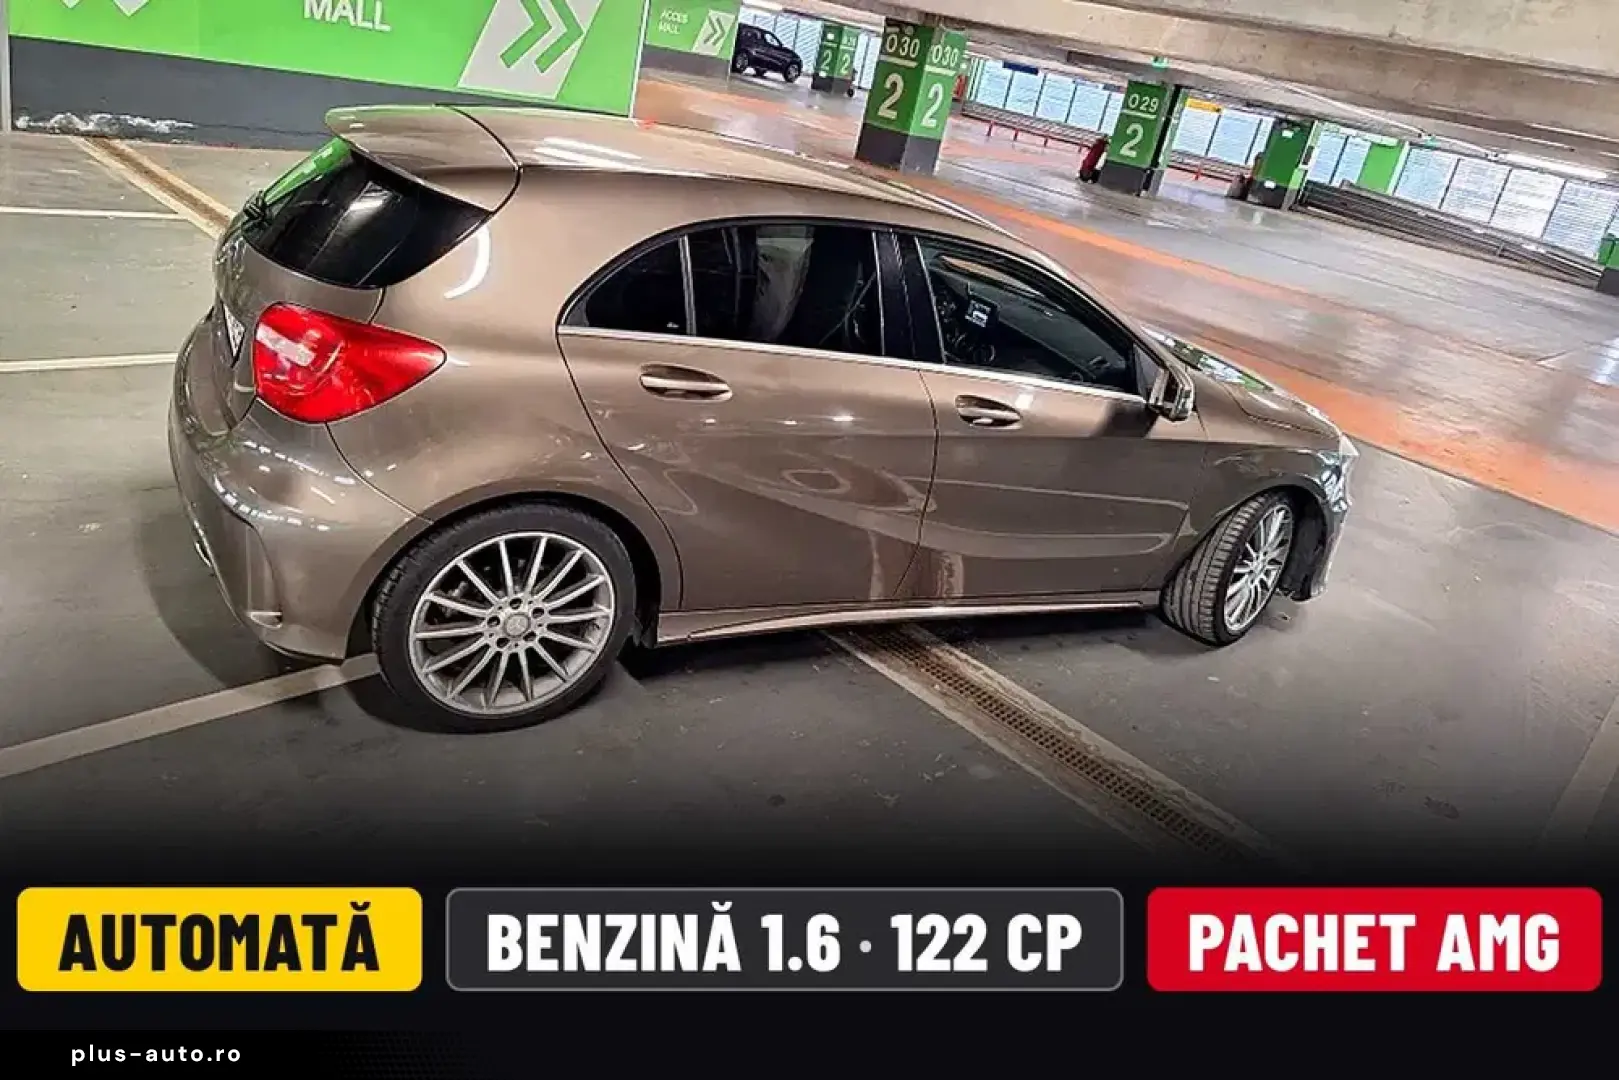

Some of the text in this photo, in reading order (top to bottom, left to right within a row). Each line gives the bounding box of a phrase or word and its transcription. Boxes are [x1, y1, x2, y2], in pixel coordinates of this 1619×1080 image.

[303, 0, 391, 32] MALL
[820, 49, 833, 71] 2
[840, 53, 851, 74] 2
[877, 72, 904, 119] 2
[920, 81, 943, 128] 2
[1119, 122, 1144, 158] 2
